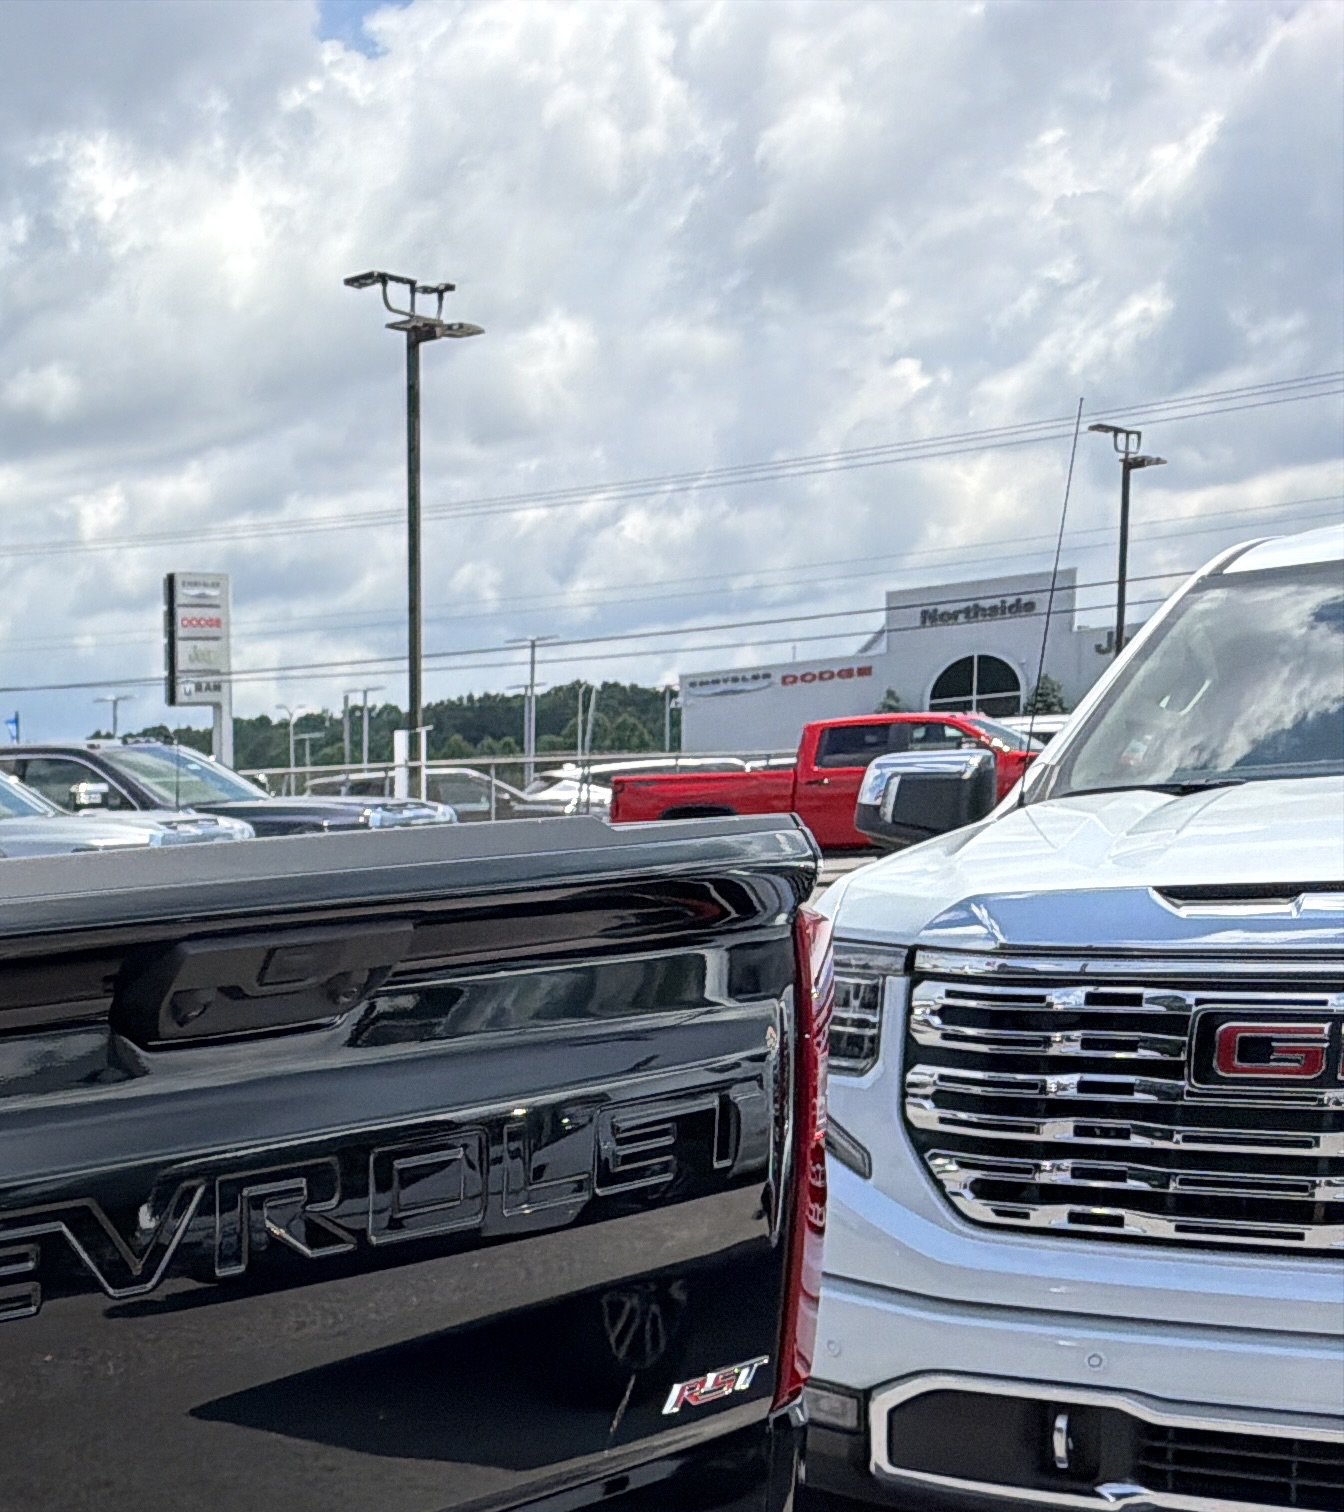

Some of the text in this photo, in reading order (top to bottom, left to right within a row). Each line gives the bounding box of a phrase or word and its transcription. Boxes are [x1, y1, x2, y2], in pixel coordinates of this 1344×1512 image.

[920, 598, 1036, 627] Northside
[181, 617, 222, 628] DODGE
[688, 672, 772, 688] CHRYSLER
[781, 665, 873, 686] DODGE
[194, 683, 222, 693] RAM
[662, 1354, 770, 1415] RST
